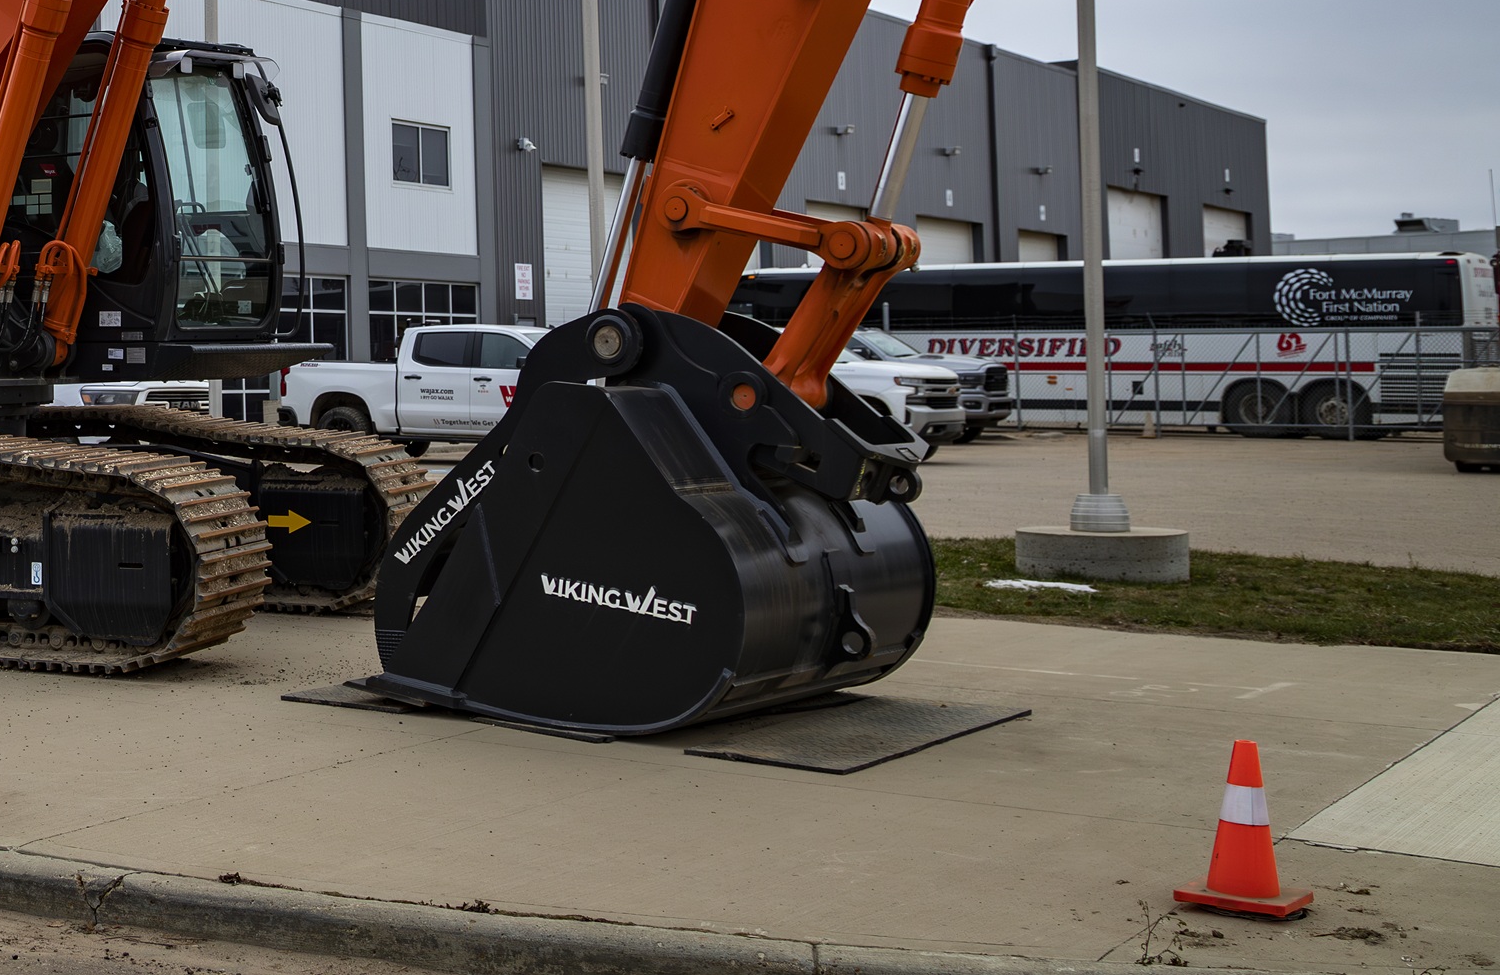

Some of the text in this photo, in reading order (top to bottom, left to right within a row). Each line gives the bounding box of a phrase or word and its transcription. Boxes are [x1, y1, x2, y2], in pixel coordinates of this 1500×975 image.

[1309, 288, 1413, 302] Fort McMurray
[1322, 301, 1400, 313] First Nation
[420, 388, 454, 396] wajax.com
[170, 401, 199, 409] RAM
[440, 418, 470, 427] Together
[394, 460, 496, 565] VIKING WEST
[541, 573, 698, 625] VIKING WEST
